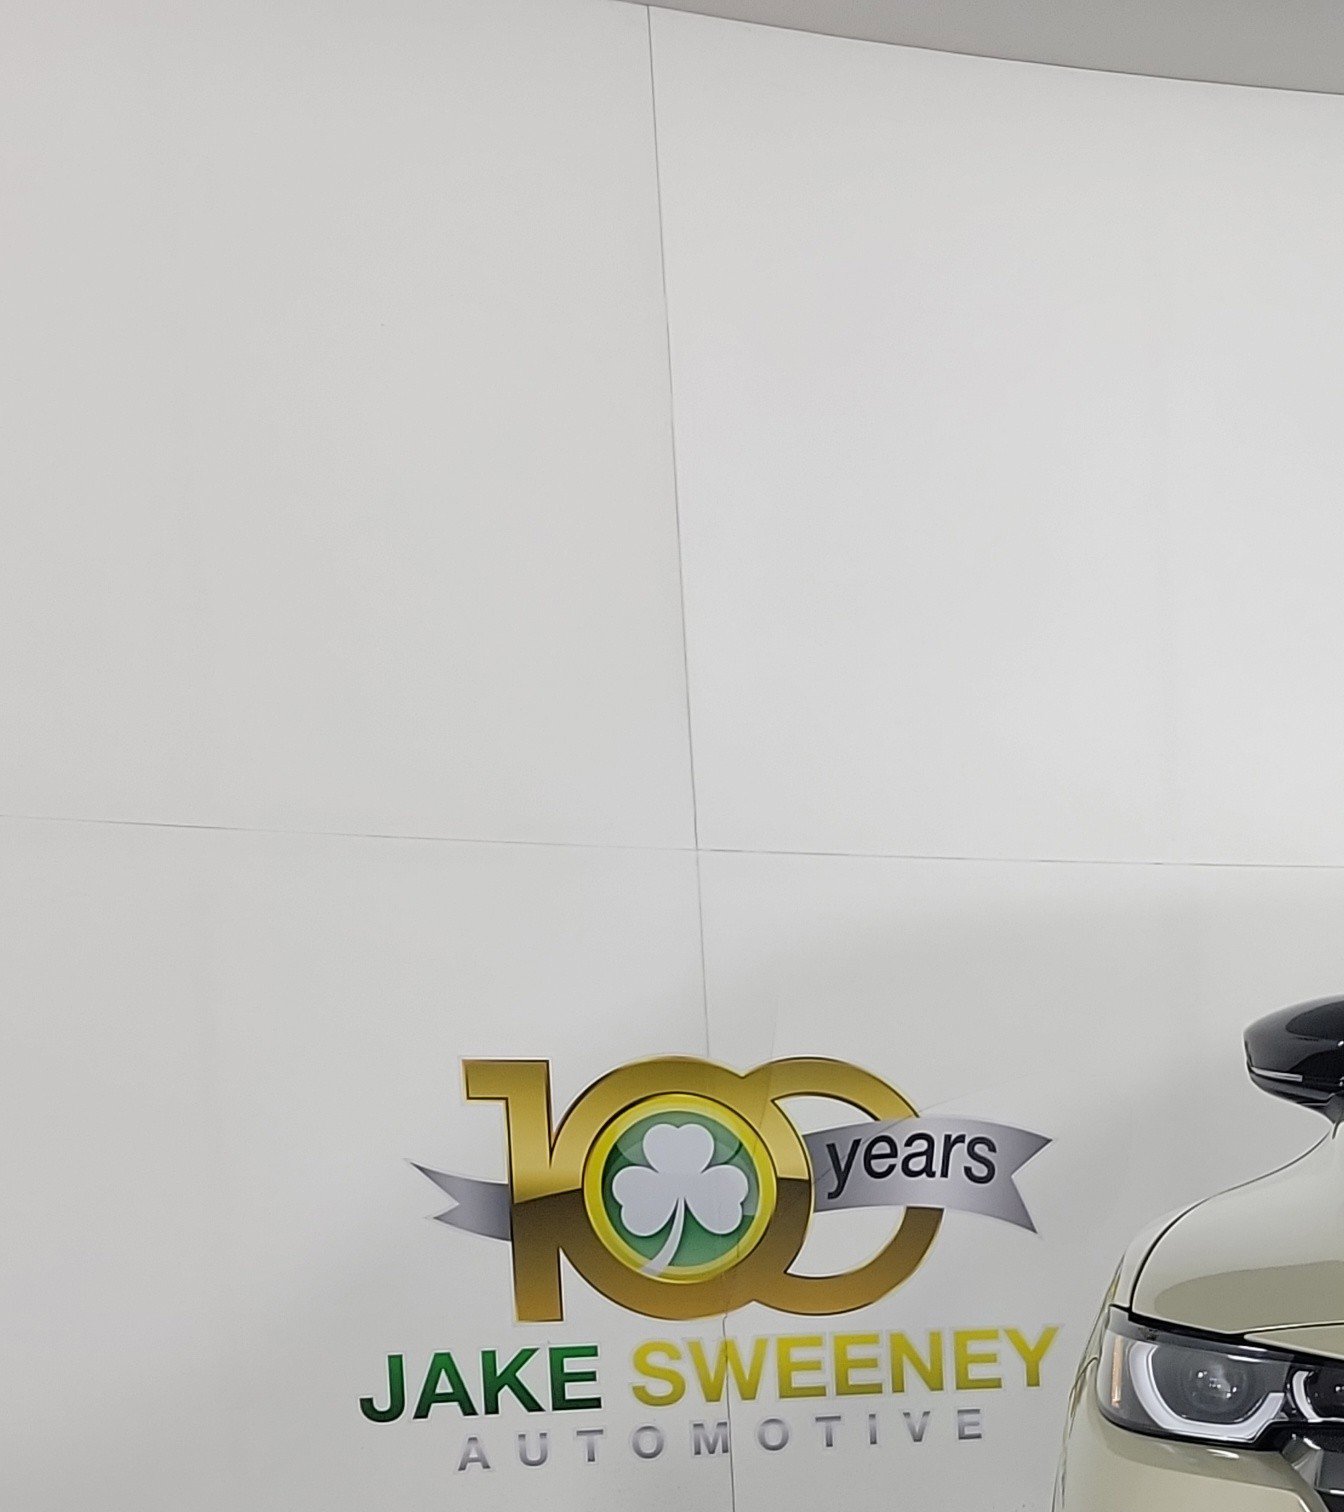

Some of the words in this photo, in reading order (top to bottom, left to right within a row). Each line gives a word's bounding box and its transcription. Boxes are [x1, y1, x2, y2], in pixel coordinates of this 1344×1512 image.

[463, 1055, 944, 1323] 100
[825, 1131, 998, 1200] years
[358, 1345, 602, 1423] JAKE
[631, 1327, 1058, 1406] SWEENEY
[457, 1409, 983, 1472] AUTOMOTIVE
